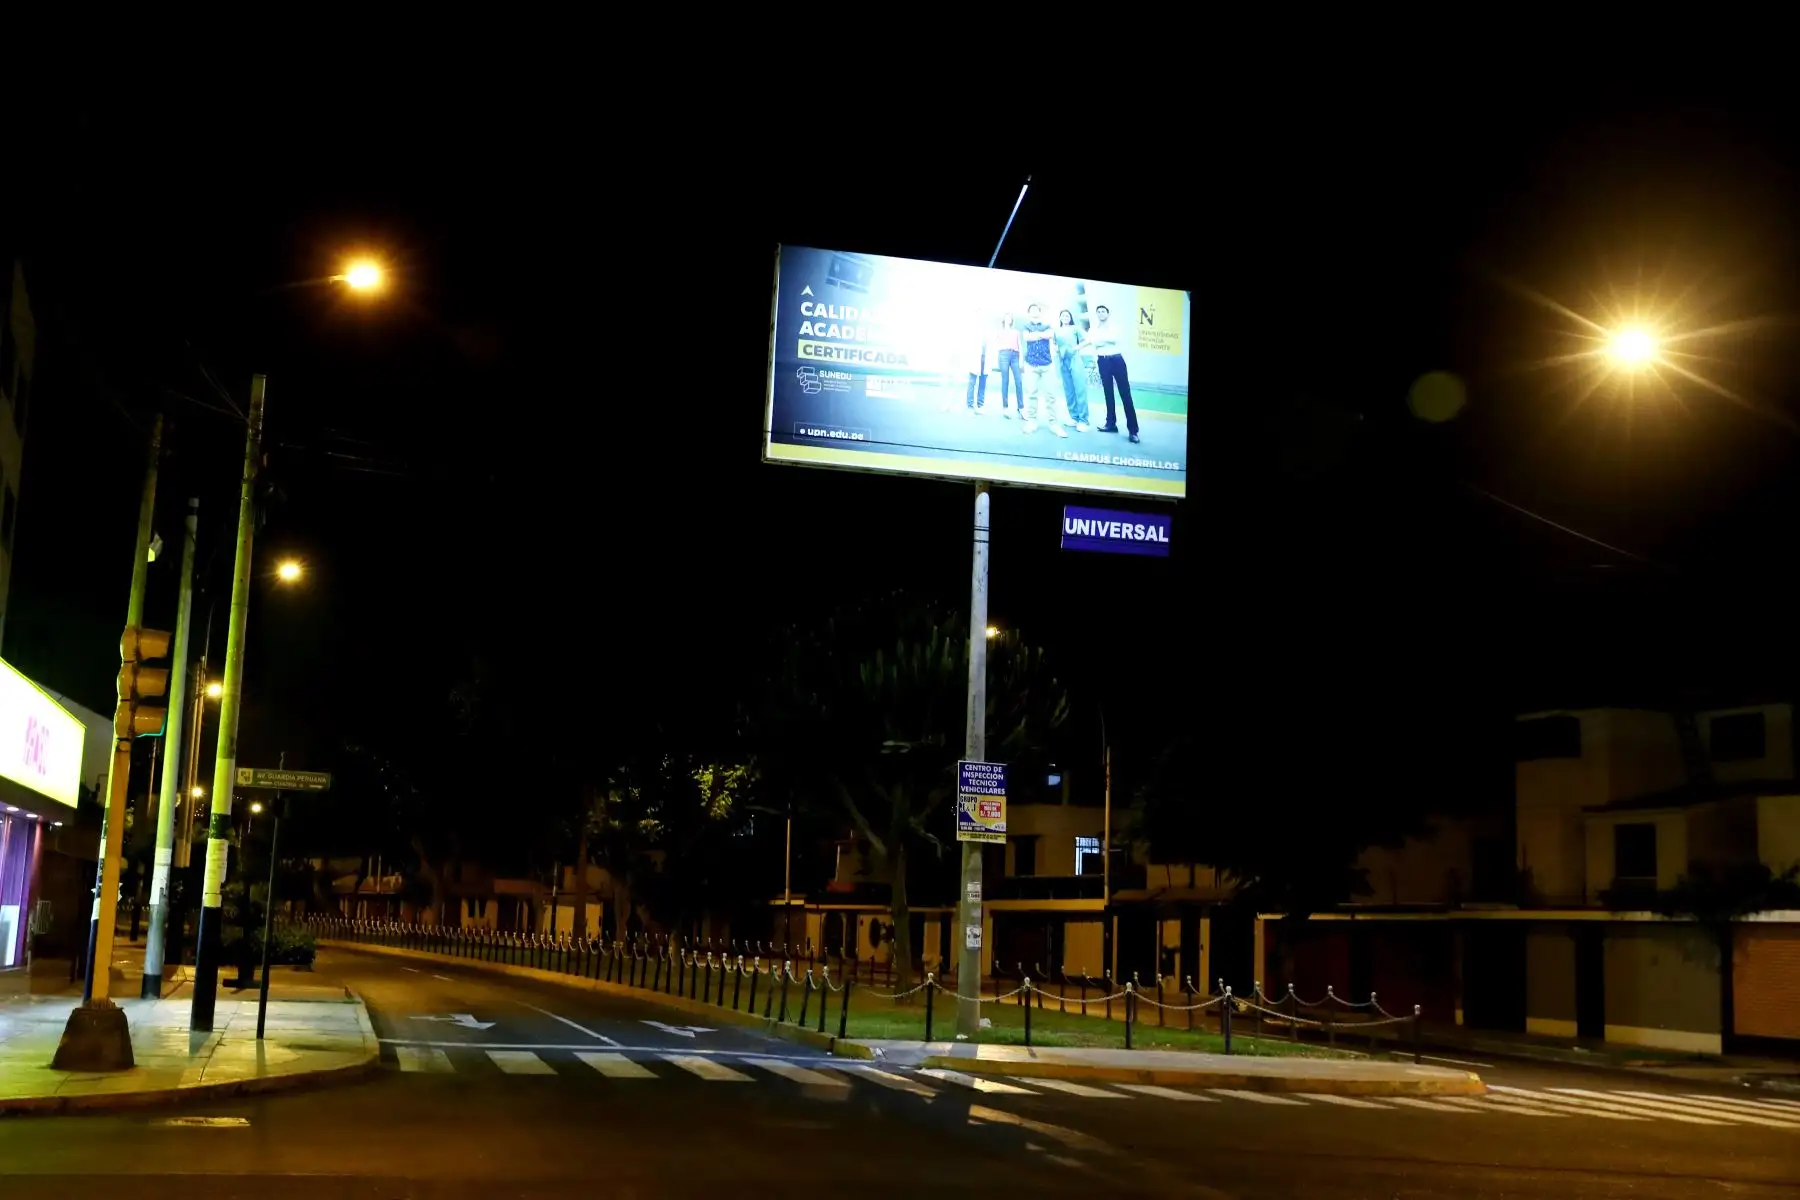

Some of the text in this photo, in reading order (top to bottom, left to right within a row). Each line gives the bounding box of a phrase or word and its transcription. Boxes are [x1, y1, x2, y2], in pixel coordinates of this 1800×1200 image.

[800, 302, 874, 322] CALIDA
[802, 344, 908, 366] CERTIFICADA
[819, 370, 852, 381] SUNEDU
[807, 427, 864, 441] upn.edu.pe
[1064, 451, 1180, 470] CAMPUS CHORRILLOS
[1065, 517, 1169, 543] UNIVERSAL
[267, 772, 296, 781] GUARDIA
[296, 775, 327, 784] PERUANA
[960, 786, 1005, 795] VEHICULARES
